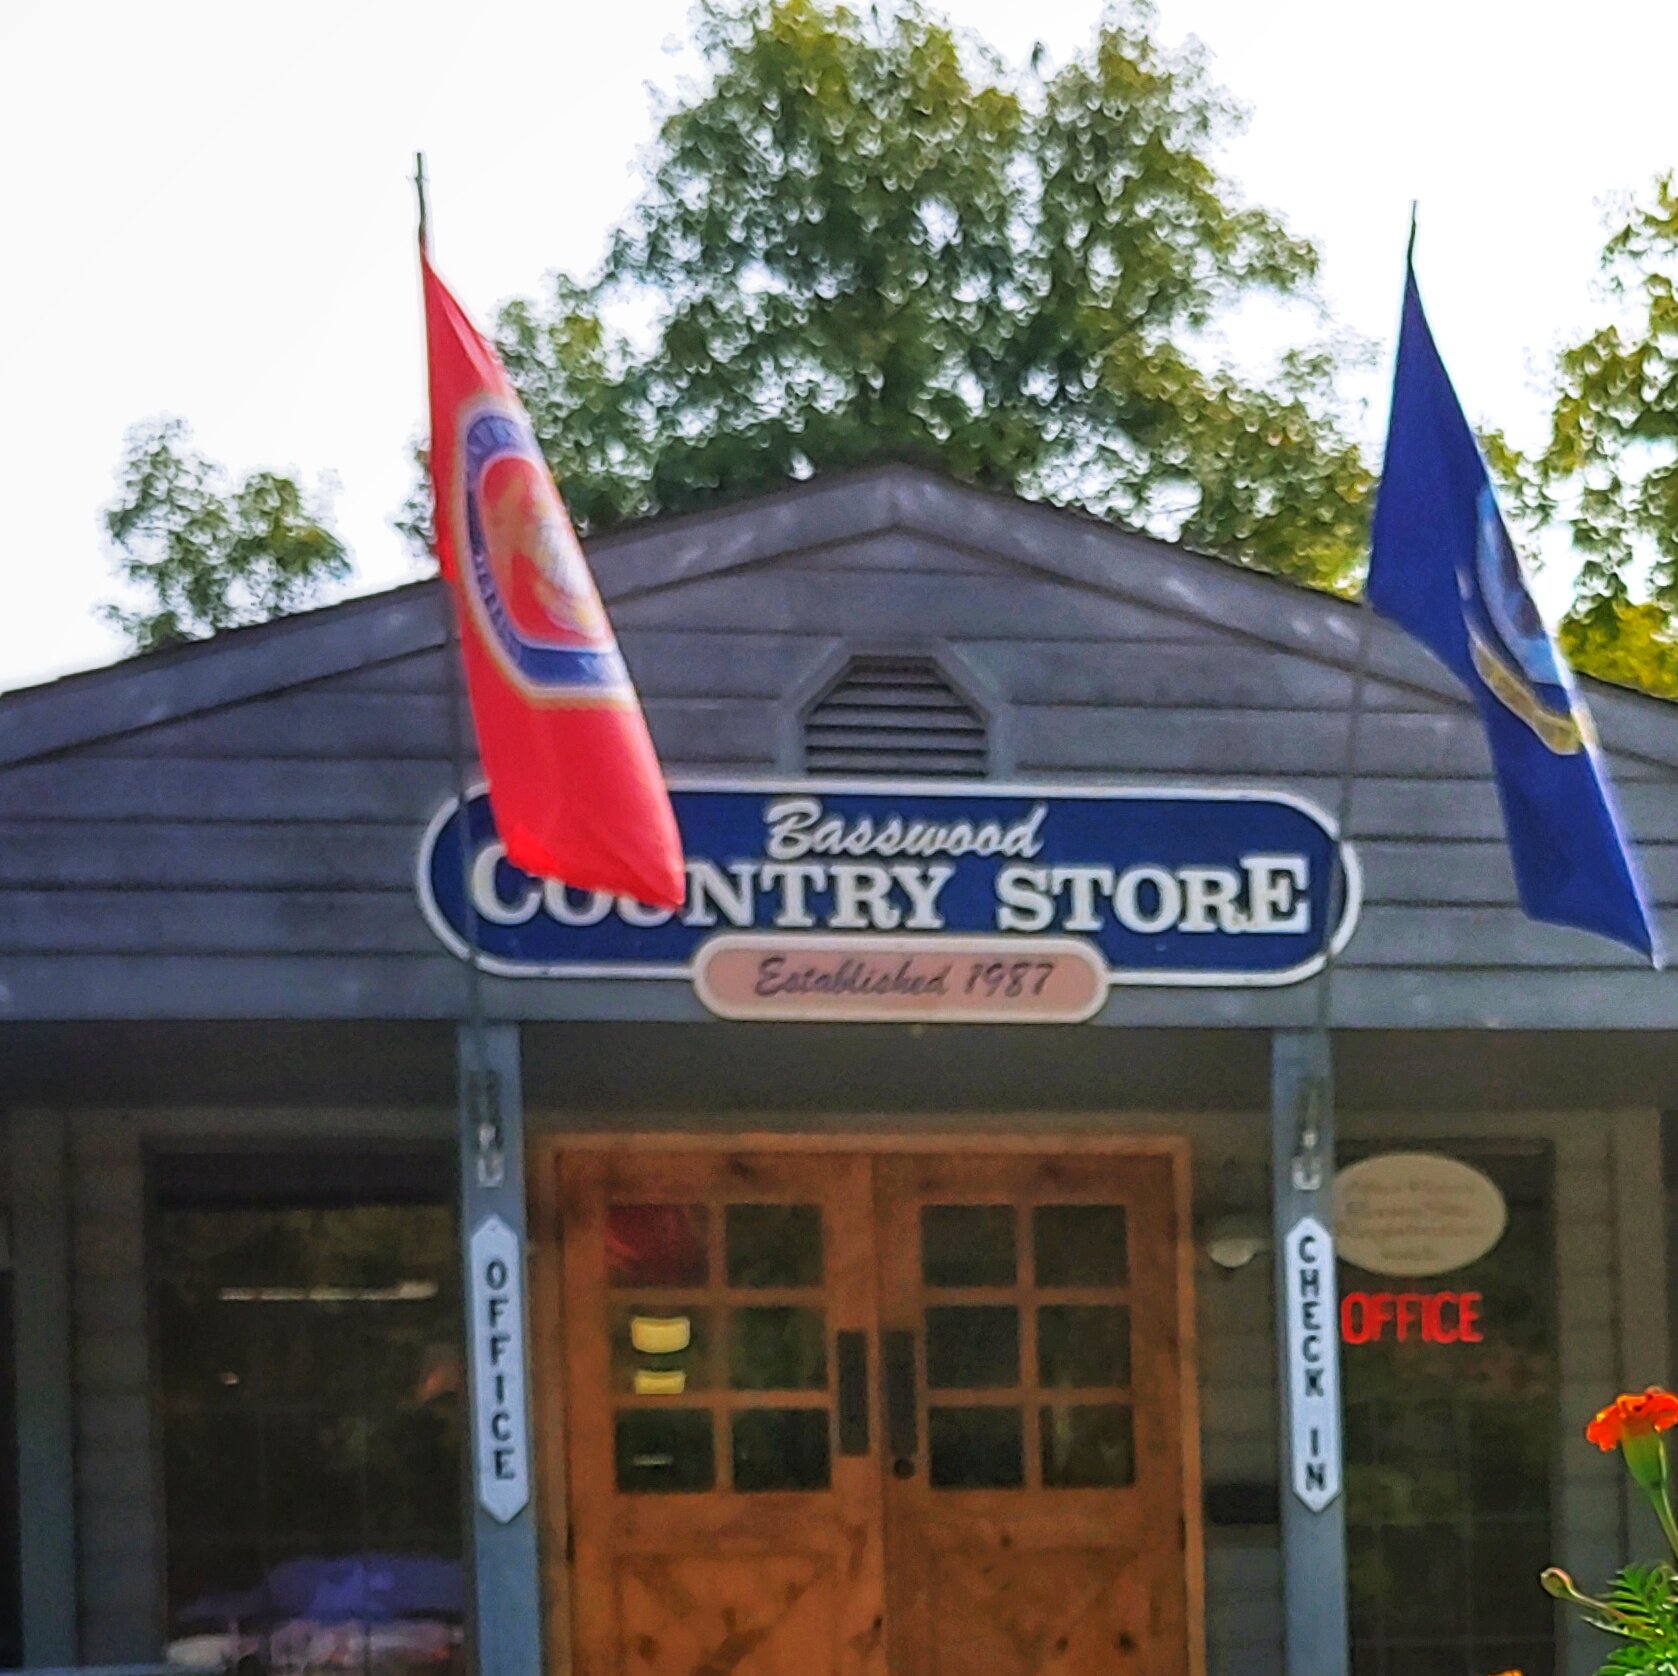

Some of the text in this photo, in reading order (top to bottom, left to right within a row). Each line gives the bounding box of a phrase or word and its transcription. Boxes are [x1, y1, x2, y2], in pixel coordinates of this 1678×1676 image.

[765, 798, 1047, 861] Basswood
[995, 854, 1309, 934] STORE
[754, 955, 1055, 998] Established 1987
[1341, 1292, 1484, 1345] OFFICE
[486, 1260, 516, 1481] OFFICE
[1298, 1236, 1327, 1492] CHECK IN
